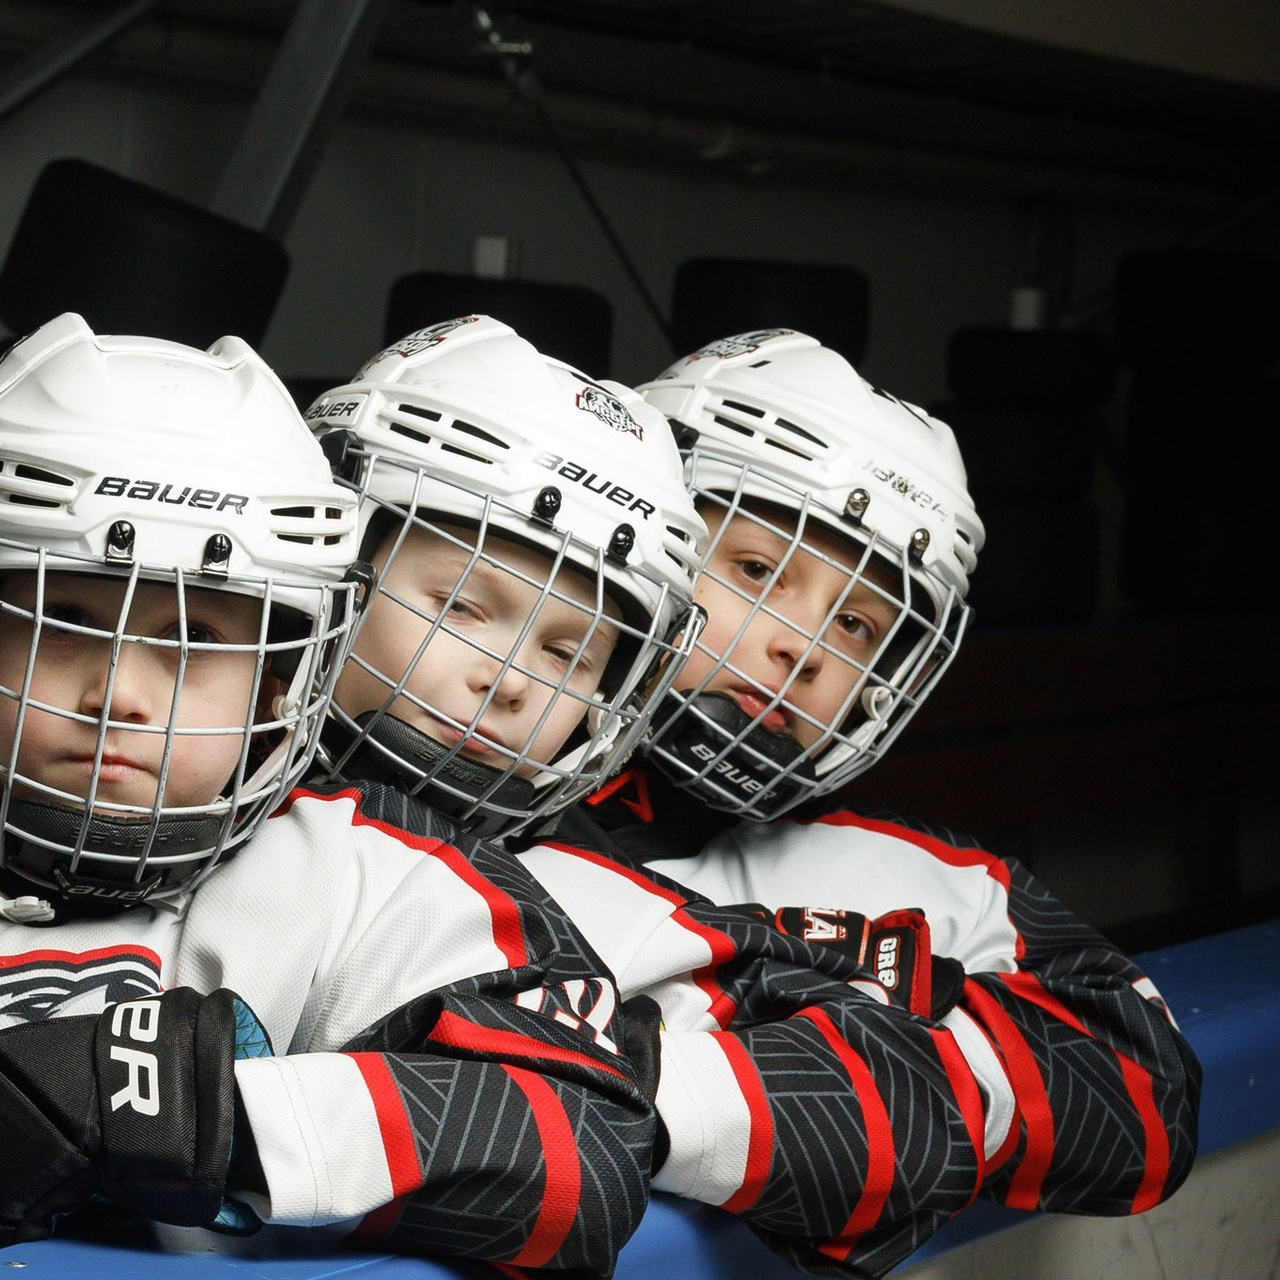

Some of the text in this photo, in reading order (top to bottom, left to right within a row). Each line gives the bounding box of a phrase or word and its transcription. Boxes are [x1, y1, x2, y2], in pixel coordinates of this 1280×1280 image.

[93, 476, 249, 515] BAUER
[531, 451, 656, 521] BAUER
[690, 743, 777, 800] BAUER
